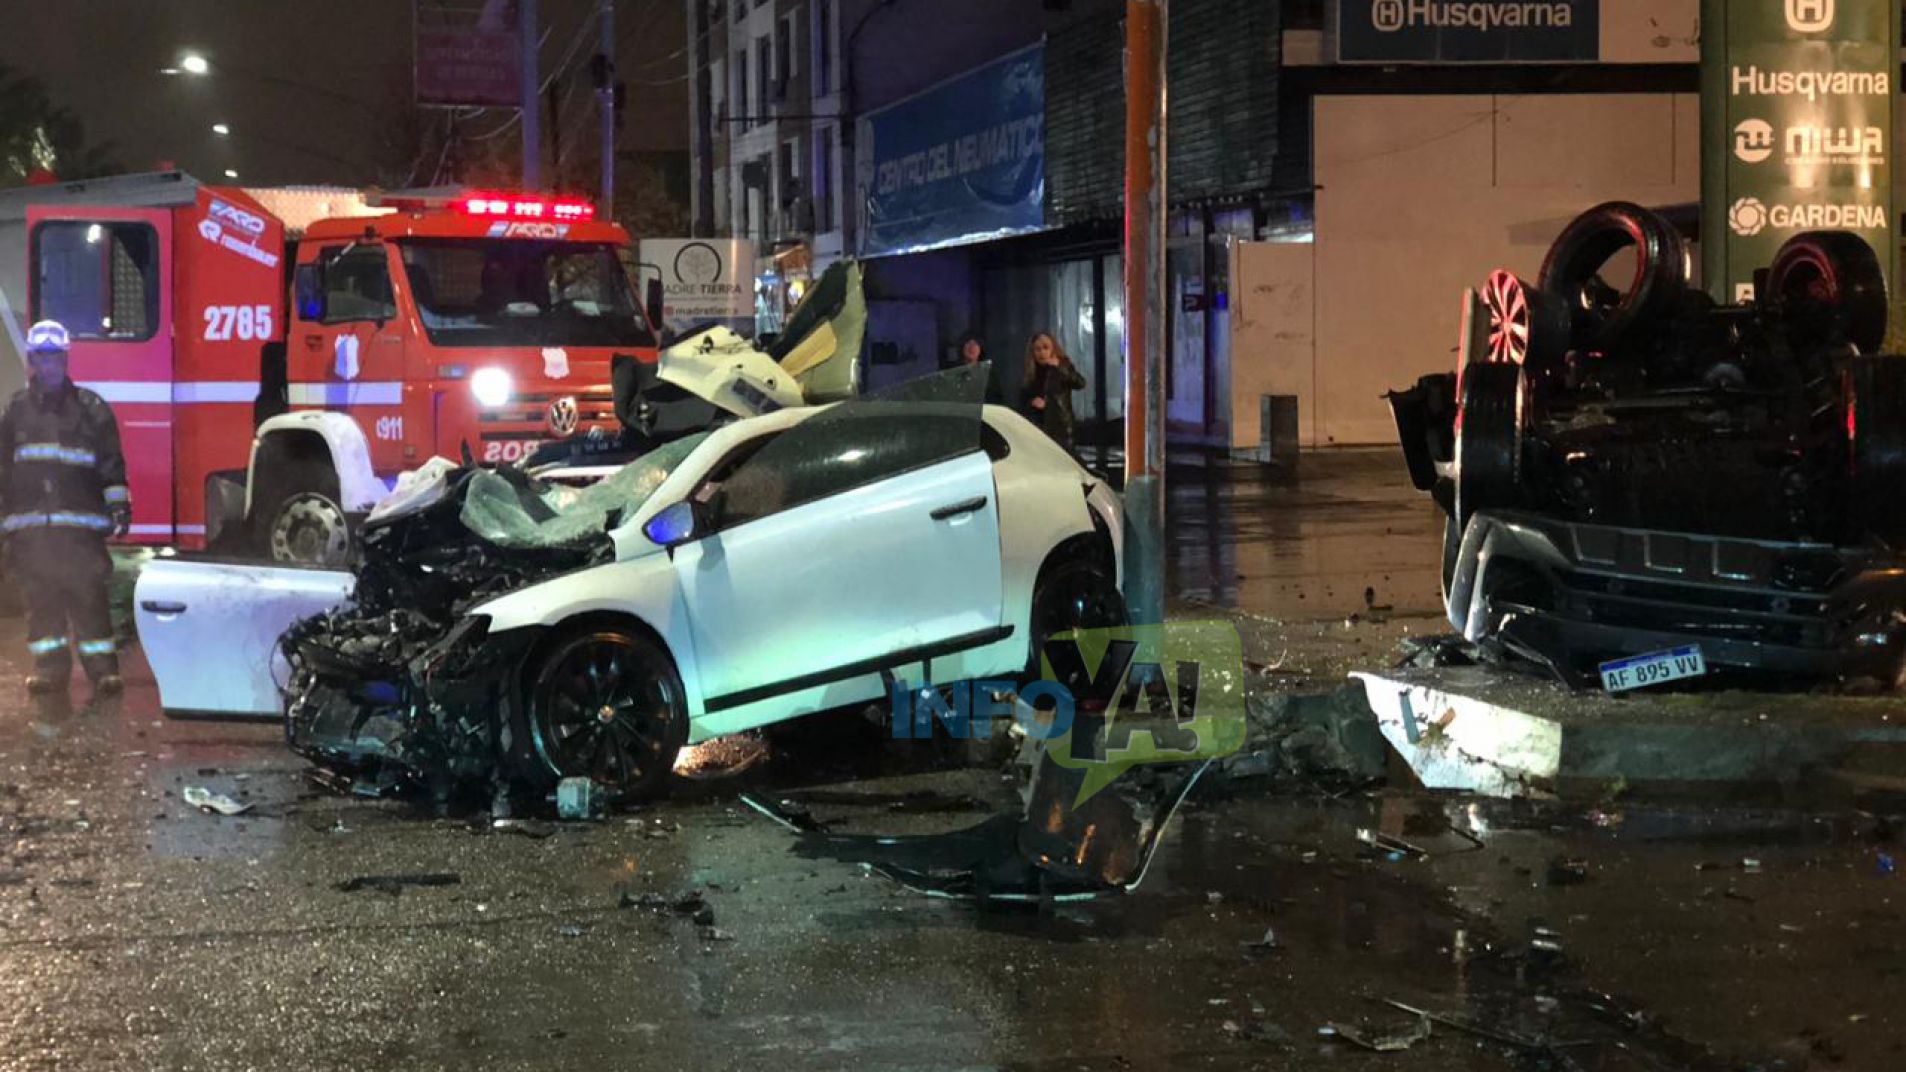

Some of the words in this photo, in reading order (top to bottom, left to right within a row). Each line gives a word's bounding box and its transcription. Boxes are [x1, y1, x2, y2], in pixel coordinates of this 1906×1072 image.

[1408, 0, 1572, 32] Husqvarna
[1732, 66, 1889, 101] Husqvarna
[928, 144, 954, 181] DEL
[1769, 204, 1887, 228] GARDENA
[664, 283, 695, 295] ADRE
[203, 305, 272, 341] 2785
[1607, 670, 1629, 689] AF
[1635, 661, 1670, 682] 895
[1674, 655, 1699, 674] VV
